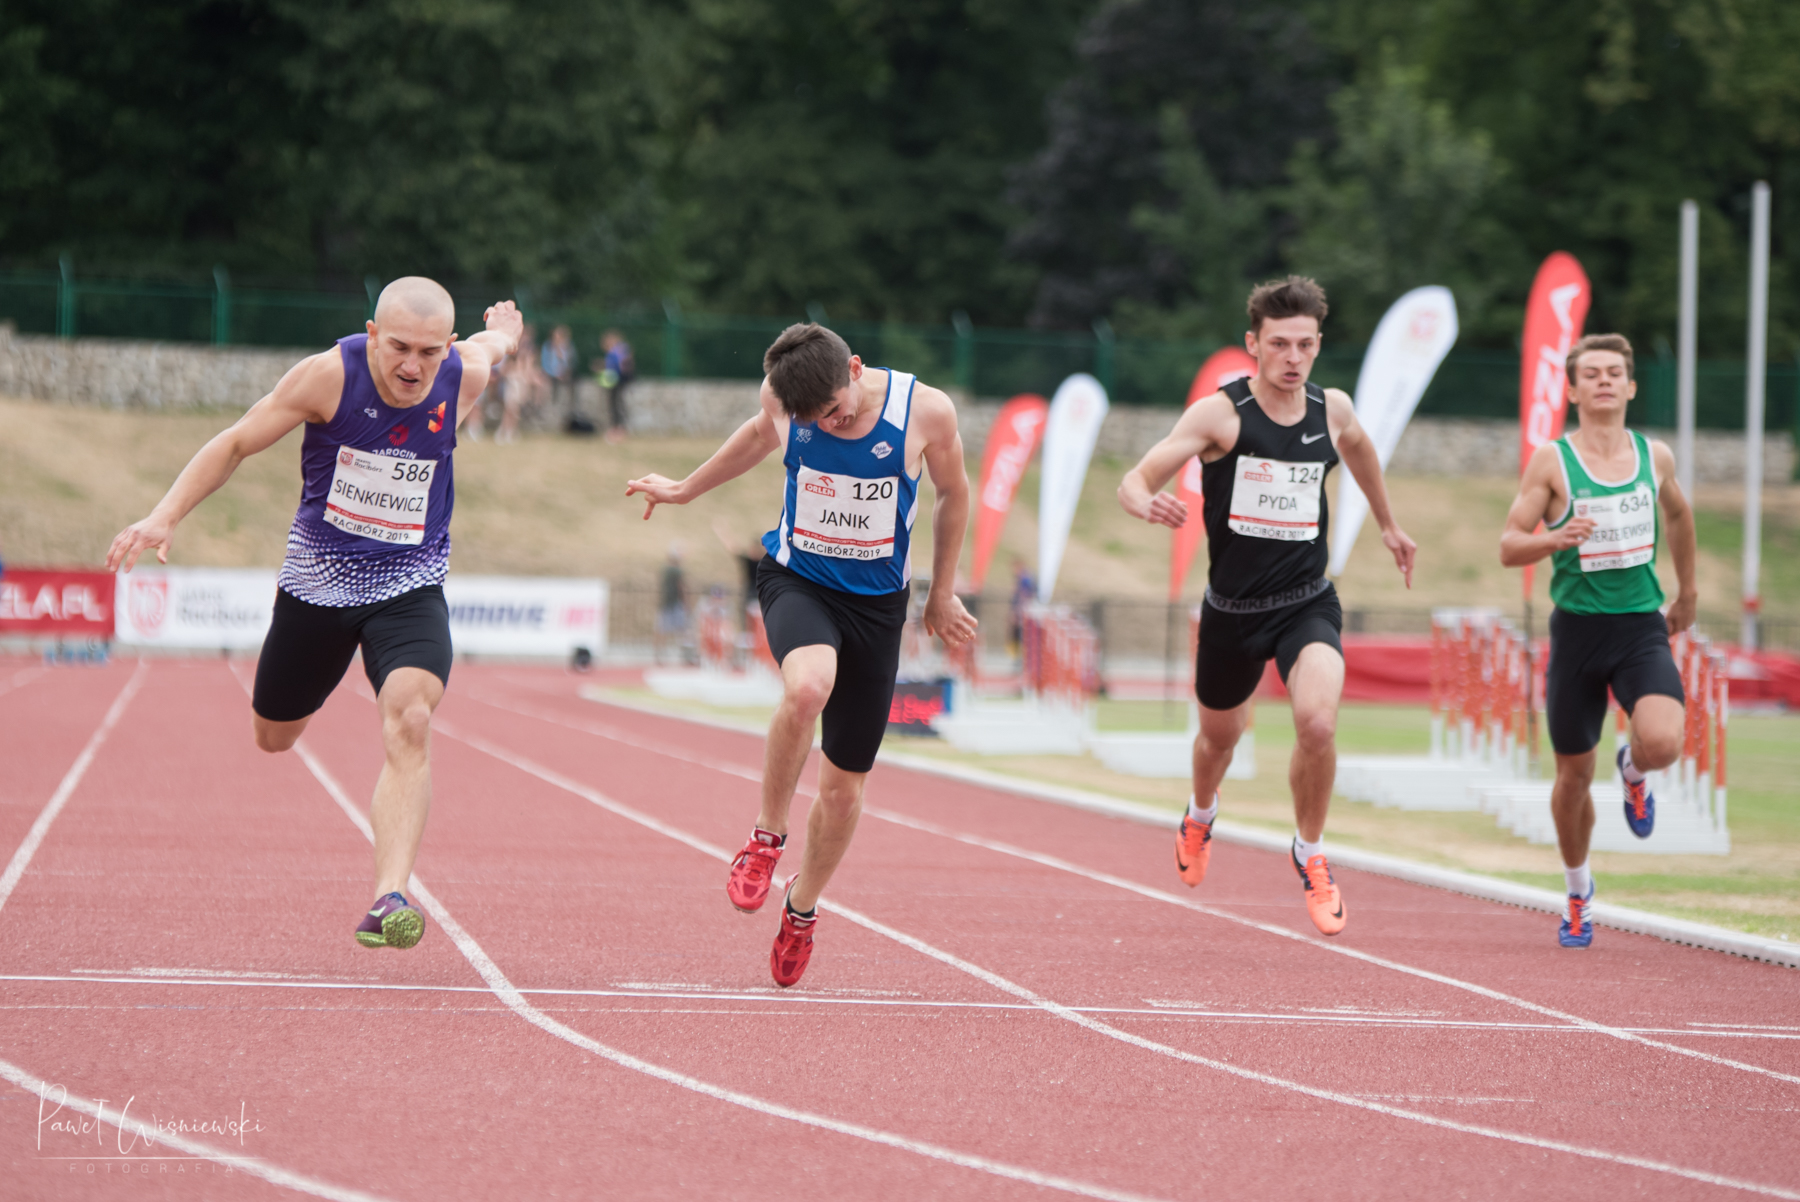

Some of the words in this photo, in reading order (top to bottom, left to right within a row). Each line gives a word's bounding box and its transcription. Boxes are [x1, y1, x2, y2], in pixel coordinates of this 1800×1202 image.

[1527, 283, 1581, 448] PZLA
[391, 462, 431, 482] 586
[1245, 473, 1272, 482] ORLEN
[1288, 467, 1319, 484] 124
[334, 479, 425, 513] SIENKIEWICZ
[806, 485, 835, 497] ORLEN
[852, 481, 893, 501] 120
[1258, 494, 1298, 511] PYDA
[1619, 494, 1649, 514] 634
[332, 515, 385, 538] RACIBÓRZ
[385, 531, 409, 541] 2019
[819, 509, 871, 529] JANIK
[1239, 525, 1286, 539] RACIBÓRZ
[1588, 522, 1651, 544] IERZEJEWSKI
[803, 540, 855, 556] RACIBÓRZ
[856, 548, 881, 558] 2019
[1230, 597, 1268, 611] NIKE
[1272, 586, 1306, 607] PRO
